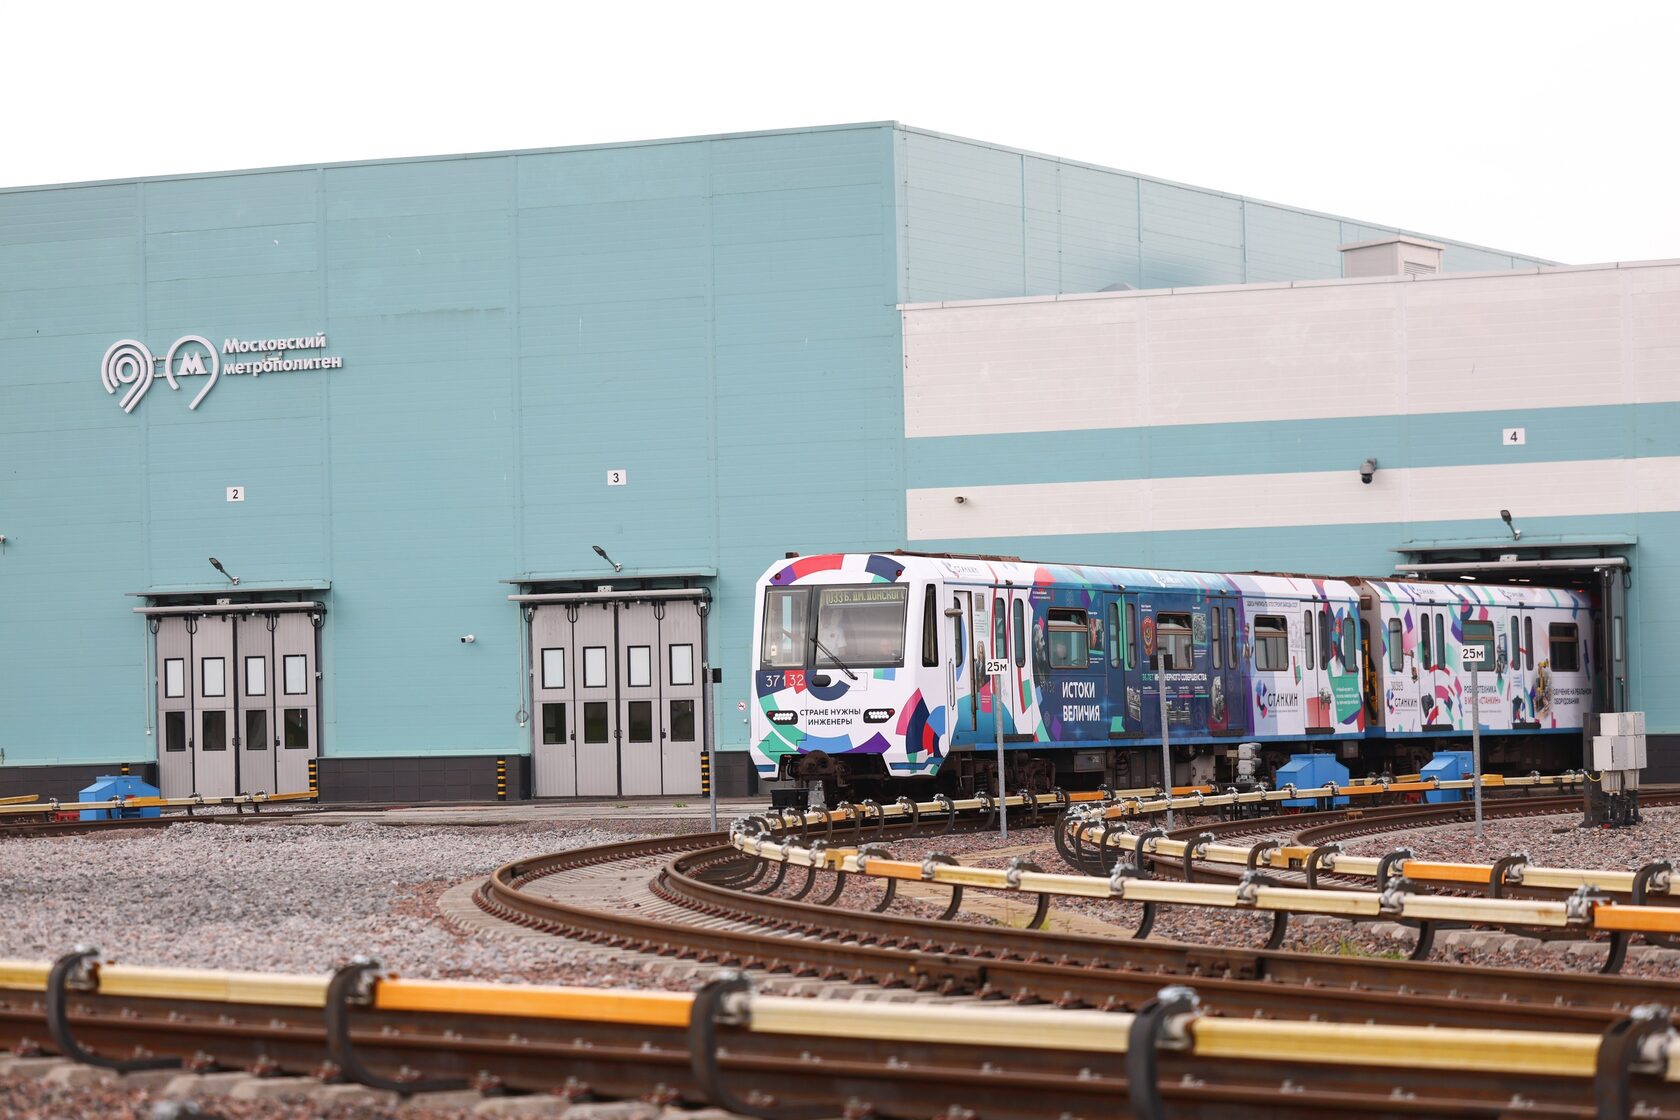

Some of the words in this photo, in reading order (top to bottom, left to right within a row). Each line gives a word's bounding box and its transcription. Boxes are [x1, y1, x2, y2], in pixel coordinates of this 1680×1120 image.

[222, 332, 327, 354] Московский
[222, 355, 343, 377] метрополитен
[1510, 431, 1518, 442] 4
[613, 472, 620, 483] 3
[232, 489, 239, 499] 2
[766, 673, 805, 688] 37132
[1062, 681, 1095, 698] ИСТОКИ
[1267, 693, 1298, 707] СТАНКИН
[1394, 698, 1418, 707] СТАНКИН
[800, 708, 829, 716] СТРАНЕ
[1063, 705, 1100, 722] ВЕЛИЧИЯ
[808, 718, 853, 726] ИНЖЕНЕРЫ
